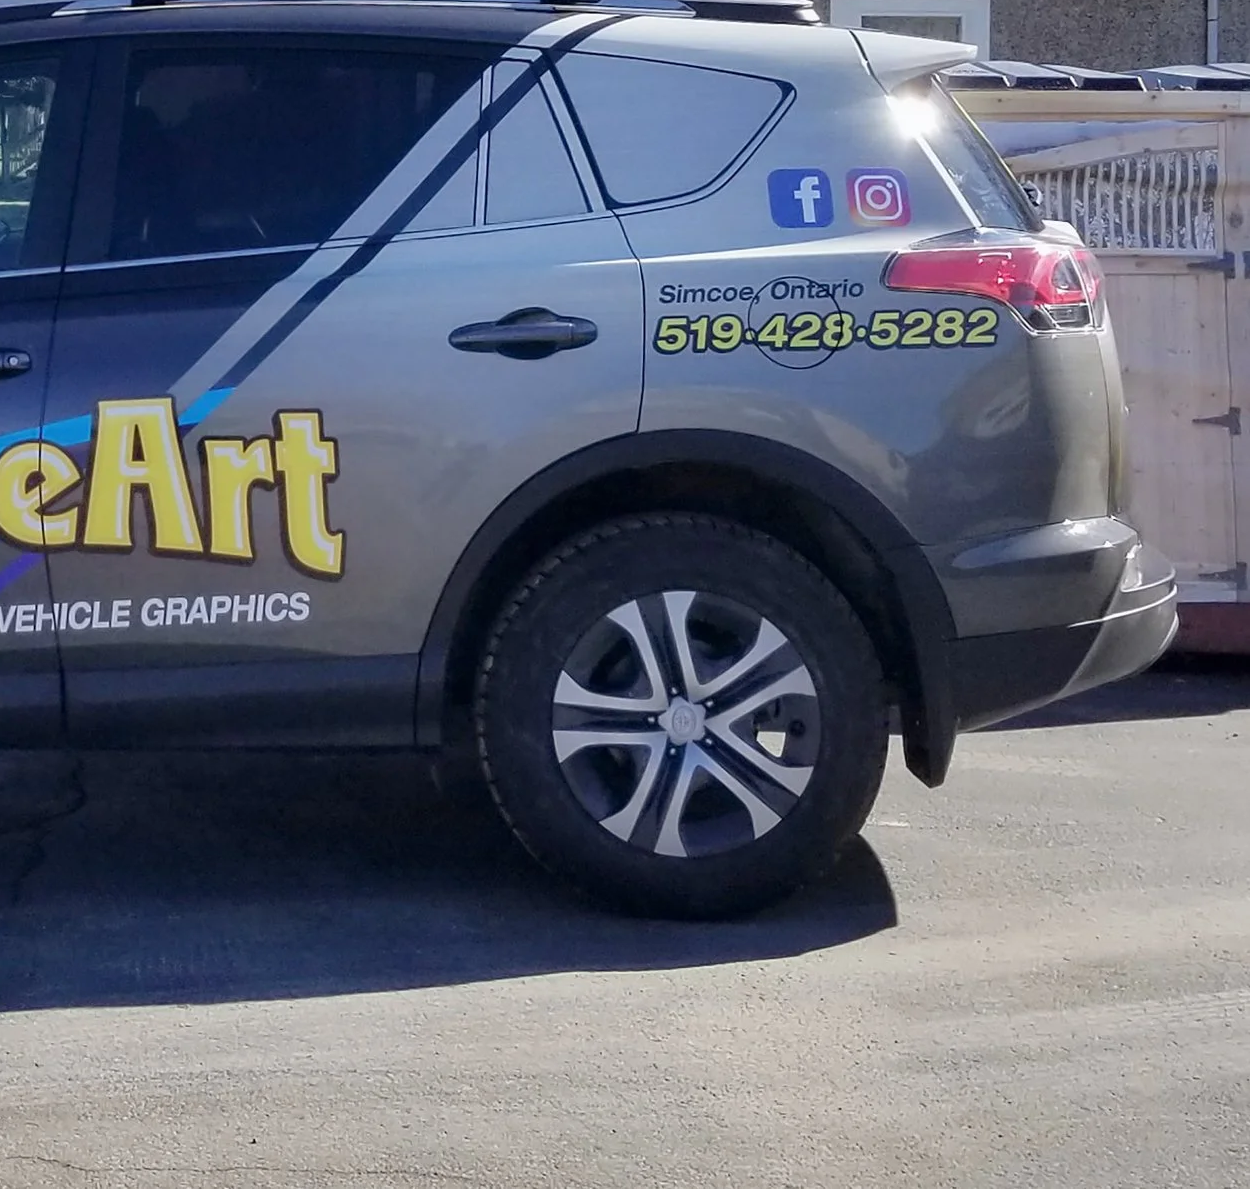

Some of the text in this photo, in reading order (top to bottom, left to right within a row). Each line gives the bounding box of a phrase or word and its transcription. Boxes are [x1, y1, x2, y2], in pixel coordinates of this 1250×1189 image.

[658, 278, 865, 305] Simcoe, Ontario
[140, 592, 312, 627] GRAPHICS
